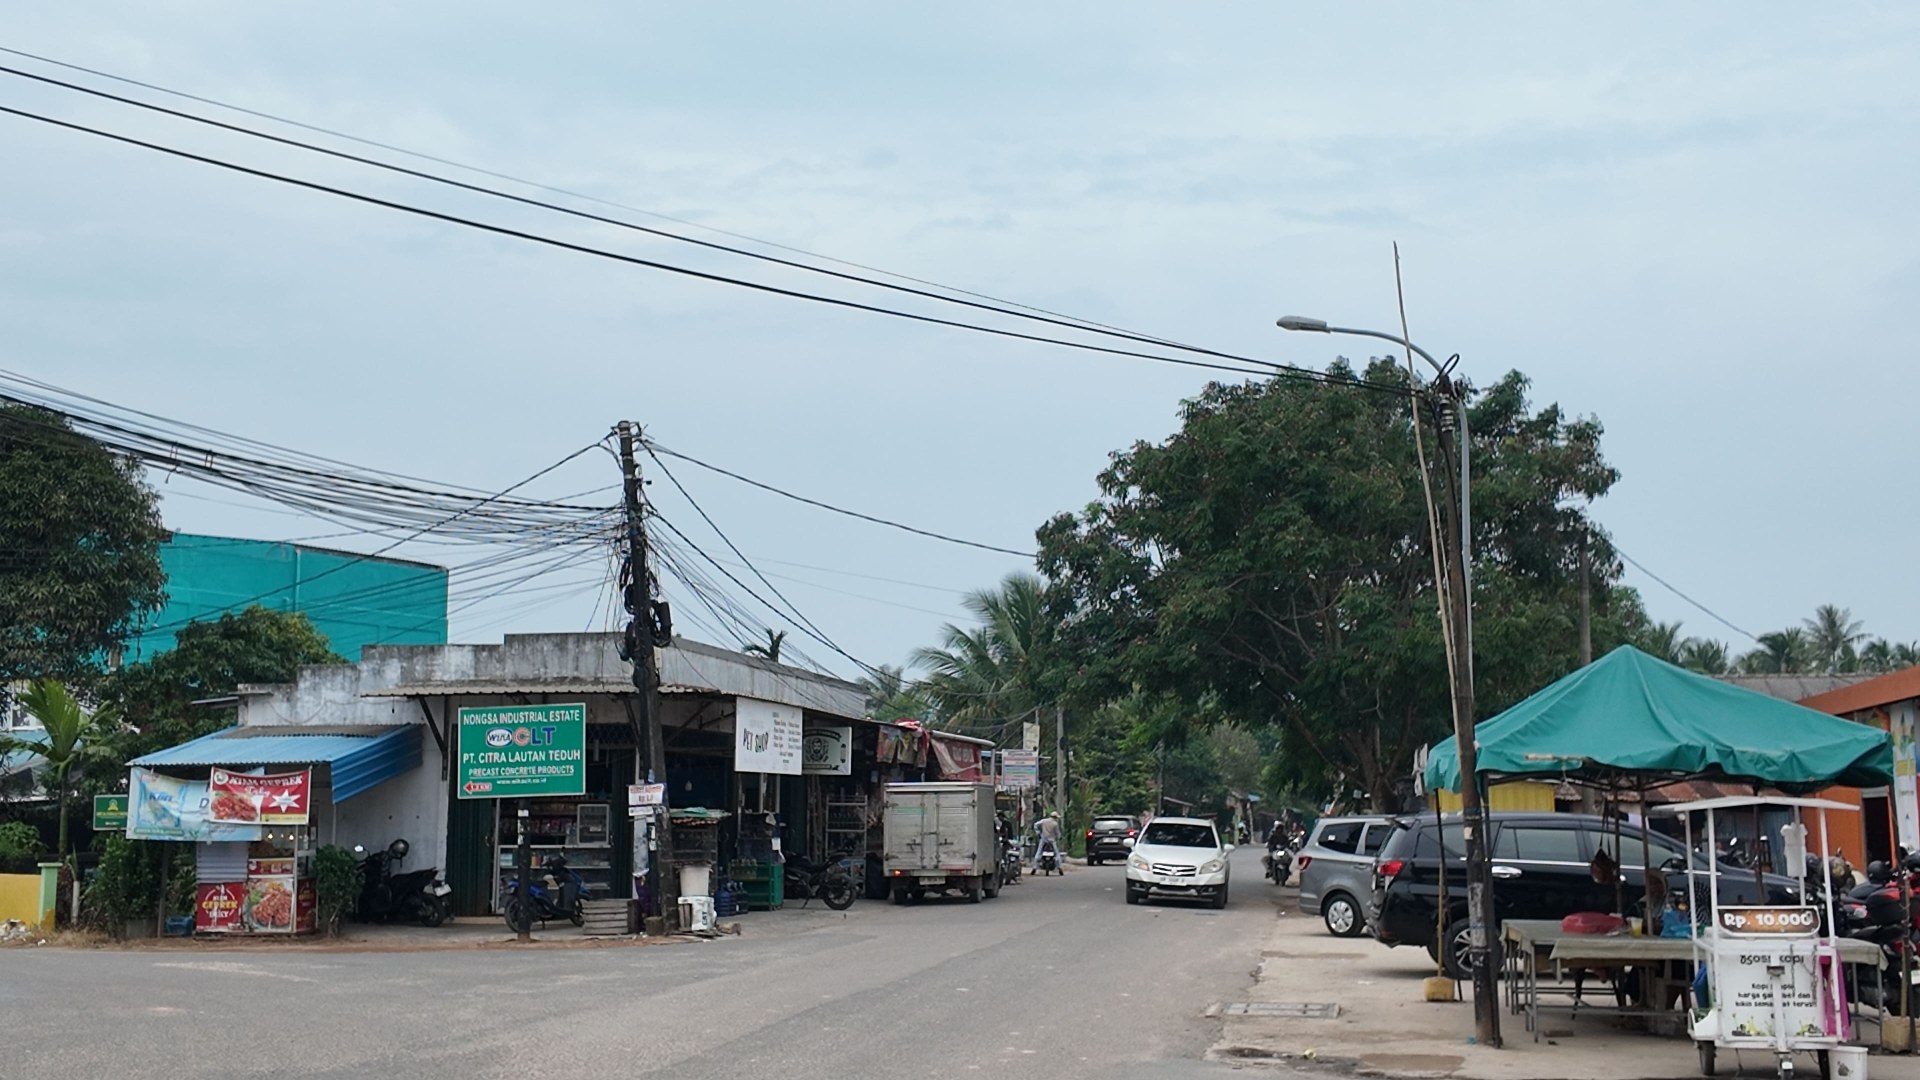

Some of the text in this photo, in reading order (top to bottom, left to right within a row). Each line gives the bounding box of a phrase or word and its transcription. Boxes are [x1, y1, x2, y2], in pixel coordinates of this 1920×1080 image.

[463, 709, 580, 725] NONGSA INDUSTRIAL ESTATE
[463, 749, 580, 765] PT. CITRA LAUTAN TEDUH
[468, 764, 575, 776] PRECAST CONCRETE PRODUCTS
[1724, 911, 1813, 928] Rp. 10.000
